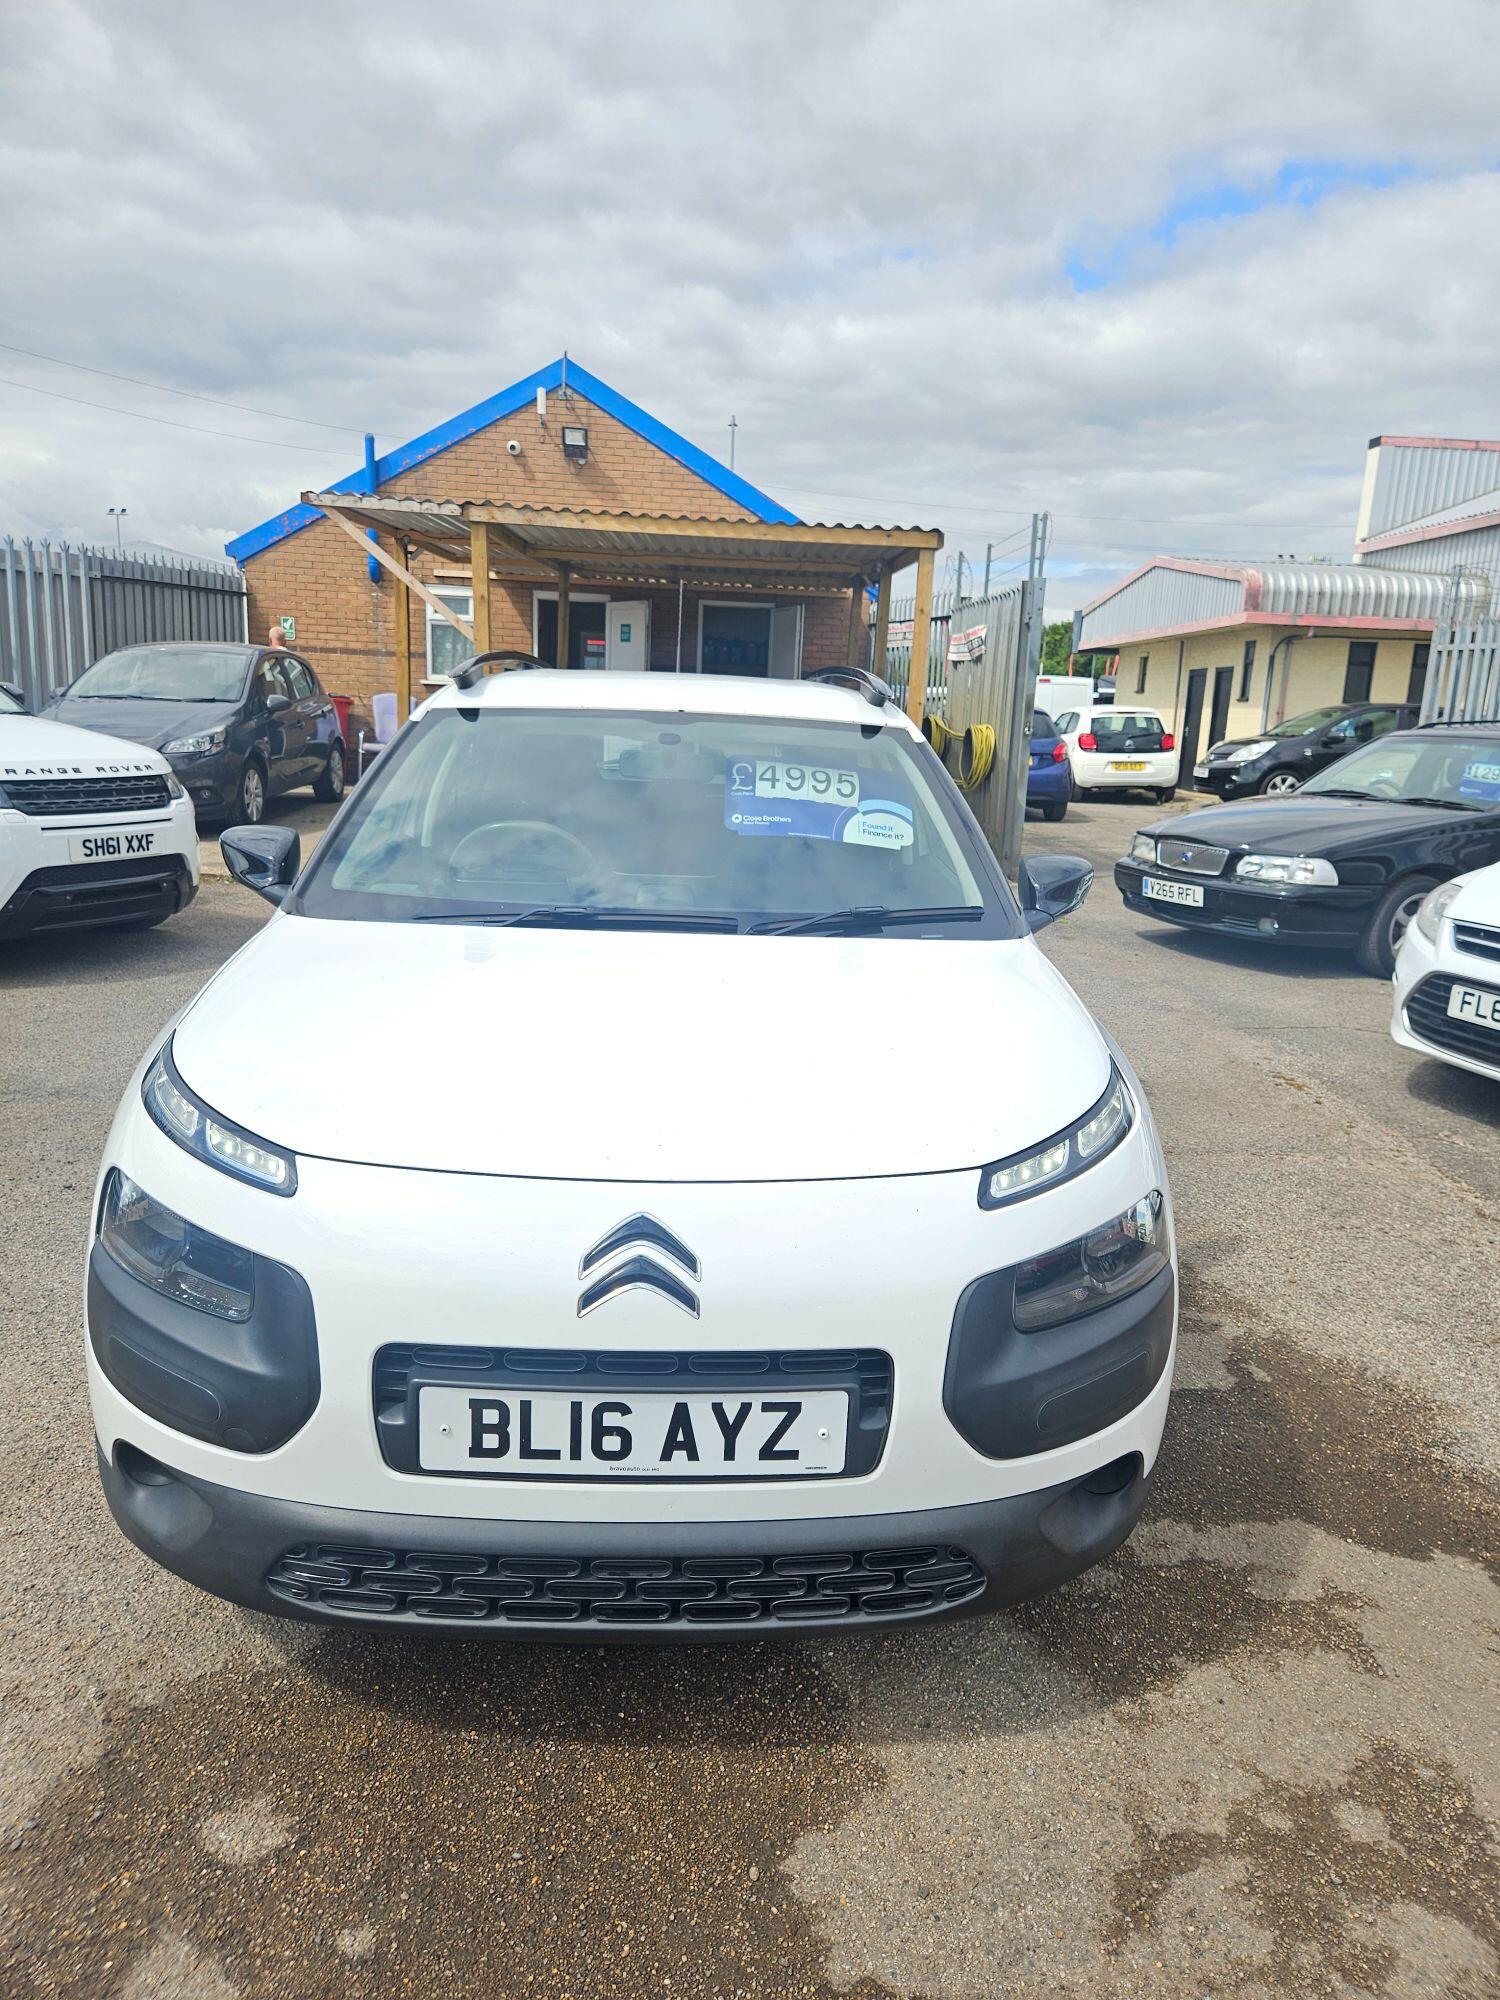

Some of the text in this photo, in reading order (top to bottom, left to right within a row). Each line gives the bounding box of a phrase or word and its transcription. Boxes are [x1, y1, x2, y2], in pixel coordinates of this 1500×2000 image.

[4, 764, 154, 776] RANGE ROVER
[743, 814, 792, 824] Close Brothers
[862, 821, 894, 832] Found it
[862, 829, 905, 841] Finance it?
[82, 833, 155, 858] SH61 XXF
[1178, 886, 1199, 903] RFL
[468, 1397, 803, 1462] BL16 AYZ
